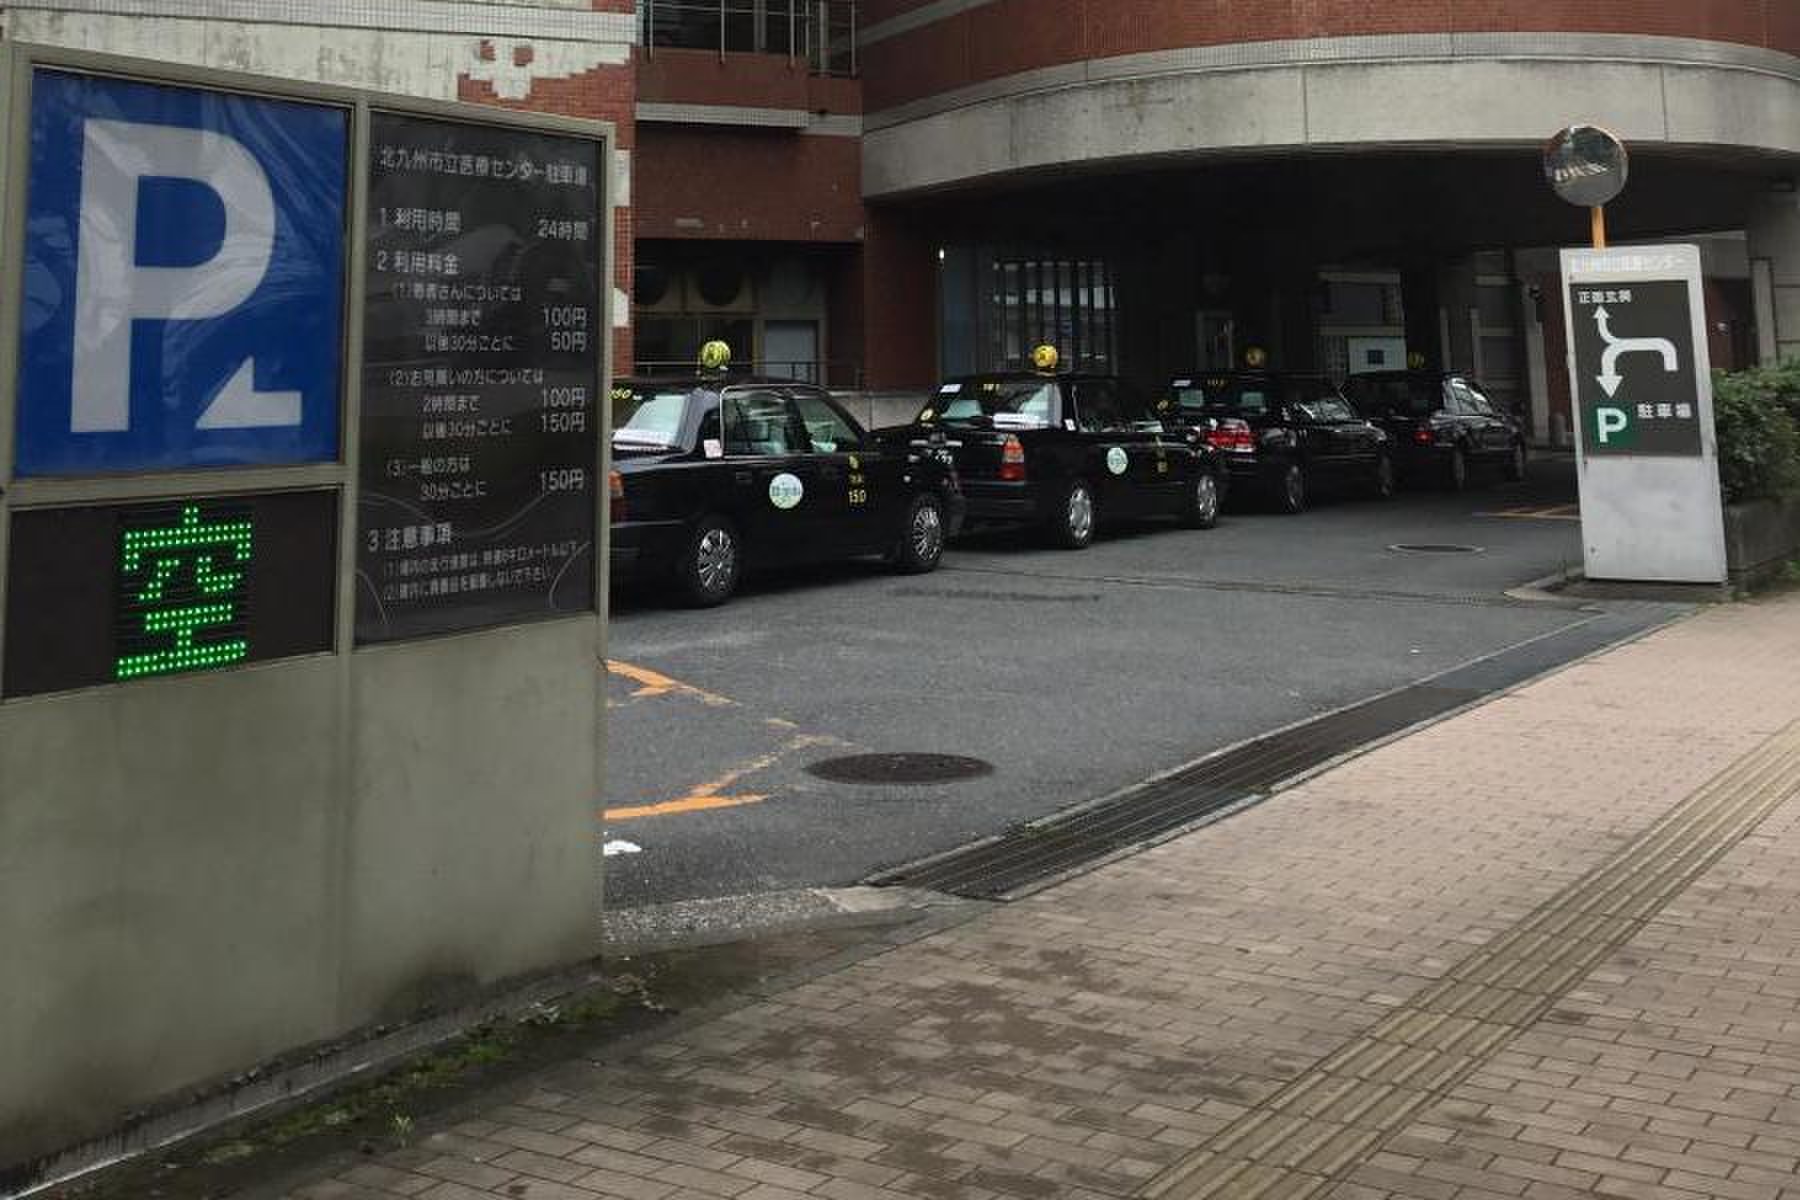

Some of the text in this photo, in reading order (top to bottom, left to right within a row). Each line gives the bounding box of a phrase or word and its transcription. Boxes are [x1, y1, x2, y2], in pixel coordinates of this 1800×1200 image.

[537, 219, 589, 241] 24時間
[70, 118, 276, 433] P
[543, 307, 587, 328] 100円
[551, 331, 587, 353] 50円
[542, 387, 586, 408] 100円
[1596, 407, 1628, 443] P
[541, 469, 585, 491] 150円
[117, 506, 252, 678] 空
